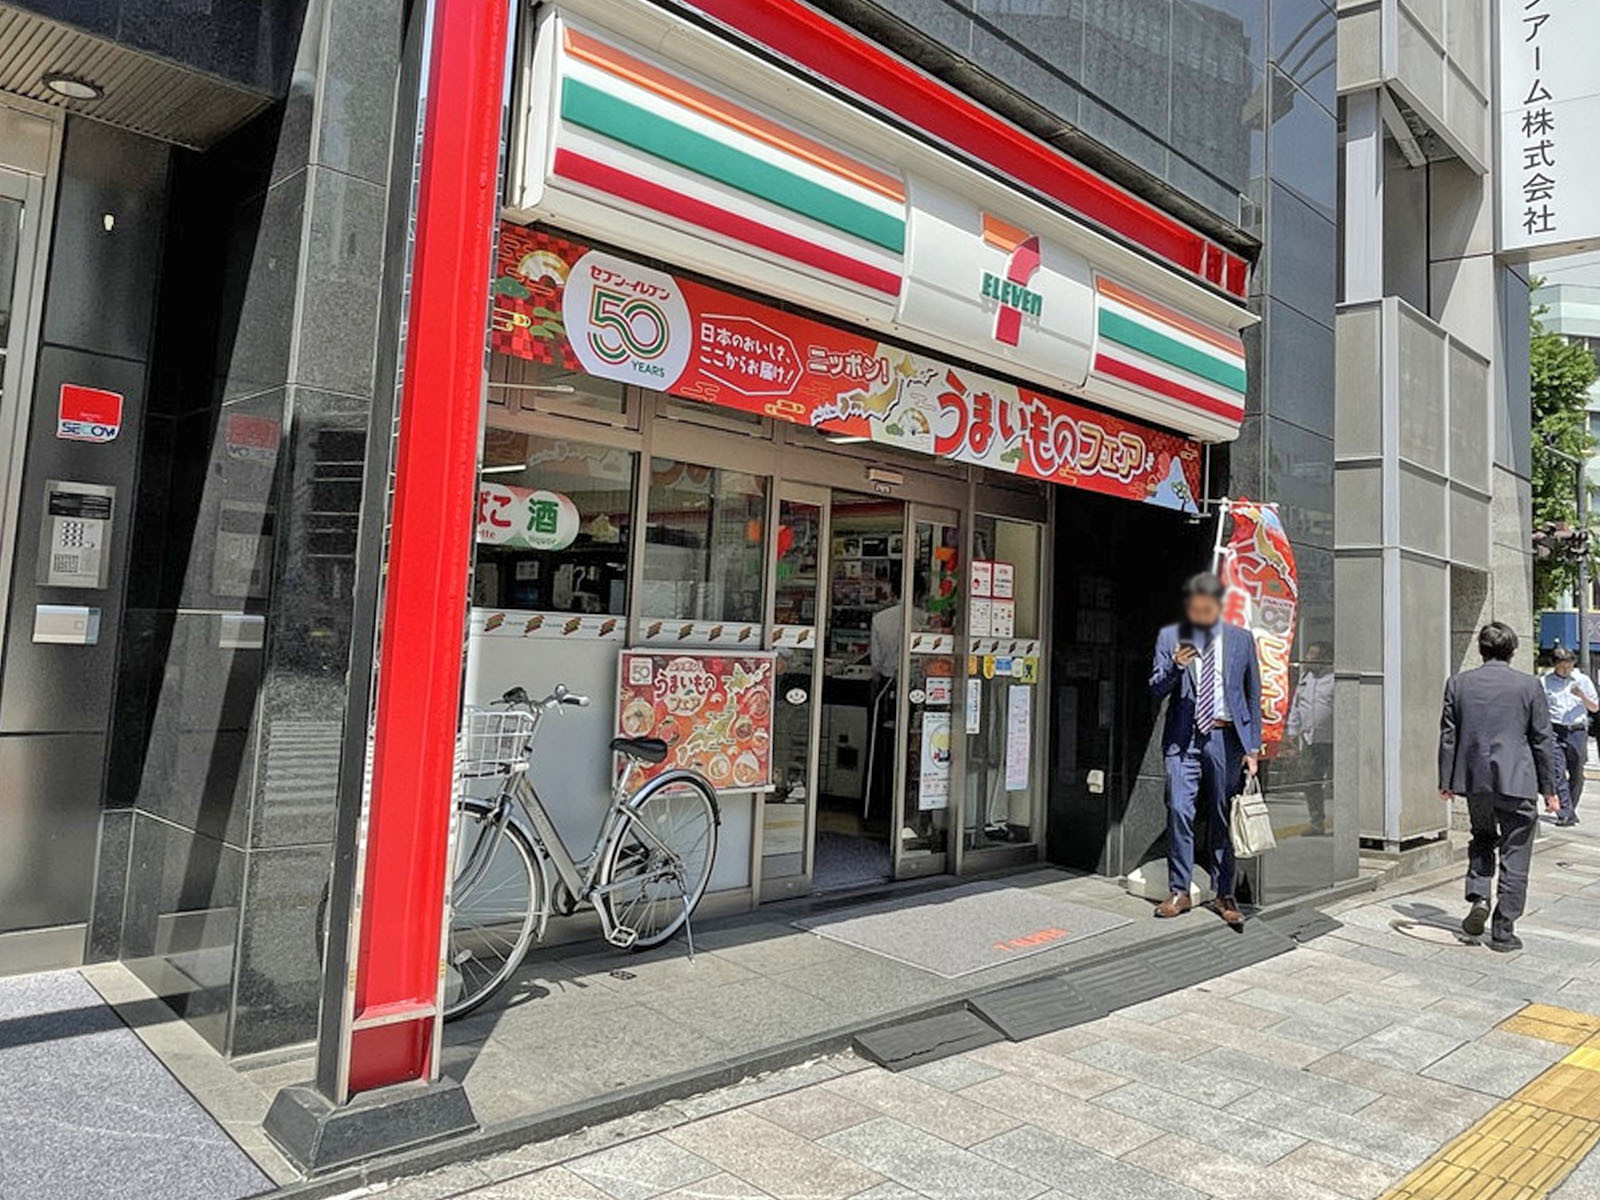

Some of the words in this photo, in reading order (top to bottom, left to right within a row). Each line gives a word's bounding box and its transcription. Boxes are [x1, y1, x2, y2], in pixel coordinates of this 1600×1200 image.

[1522, 0, 1556, 235] アーム株式会社
[981, 211, 1041, 347] 7
[586, 284, 669, 365] 50
[631, 360, 665, 378] YEARS
[61, 421, 116, 437] SECOM
[527, 498, 559, 534] 酒
[656, 672, 715, 699] うまいもの
